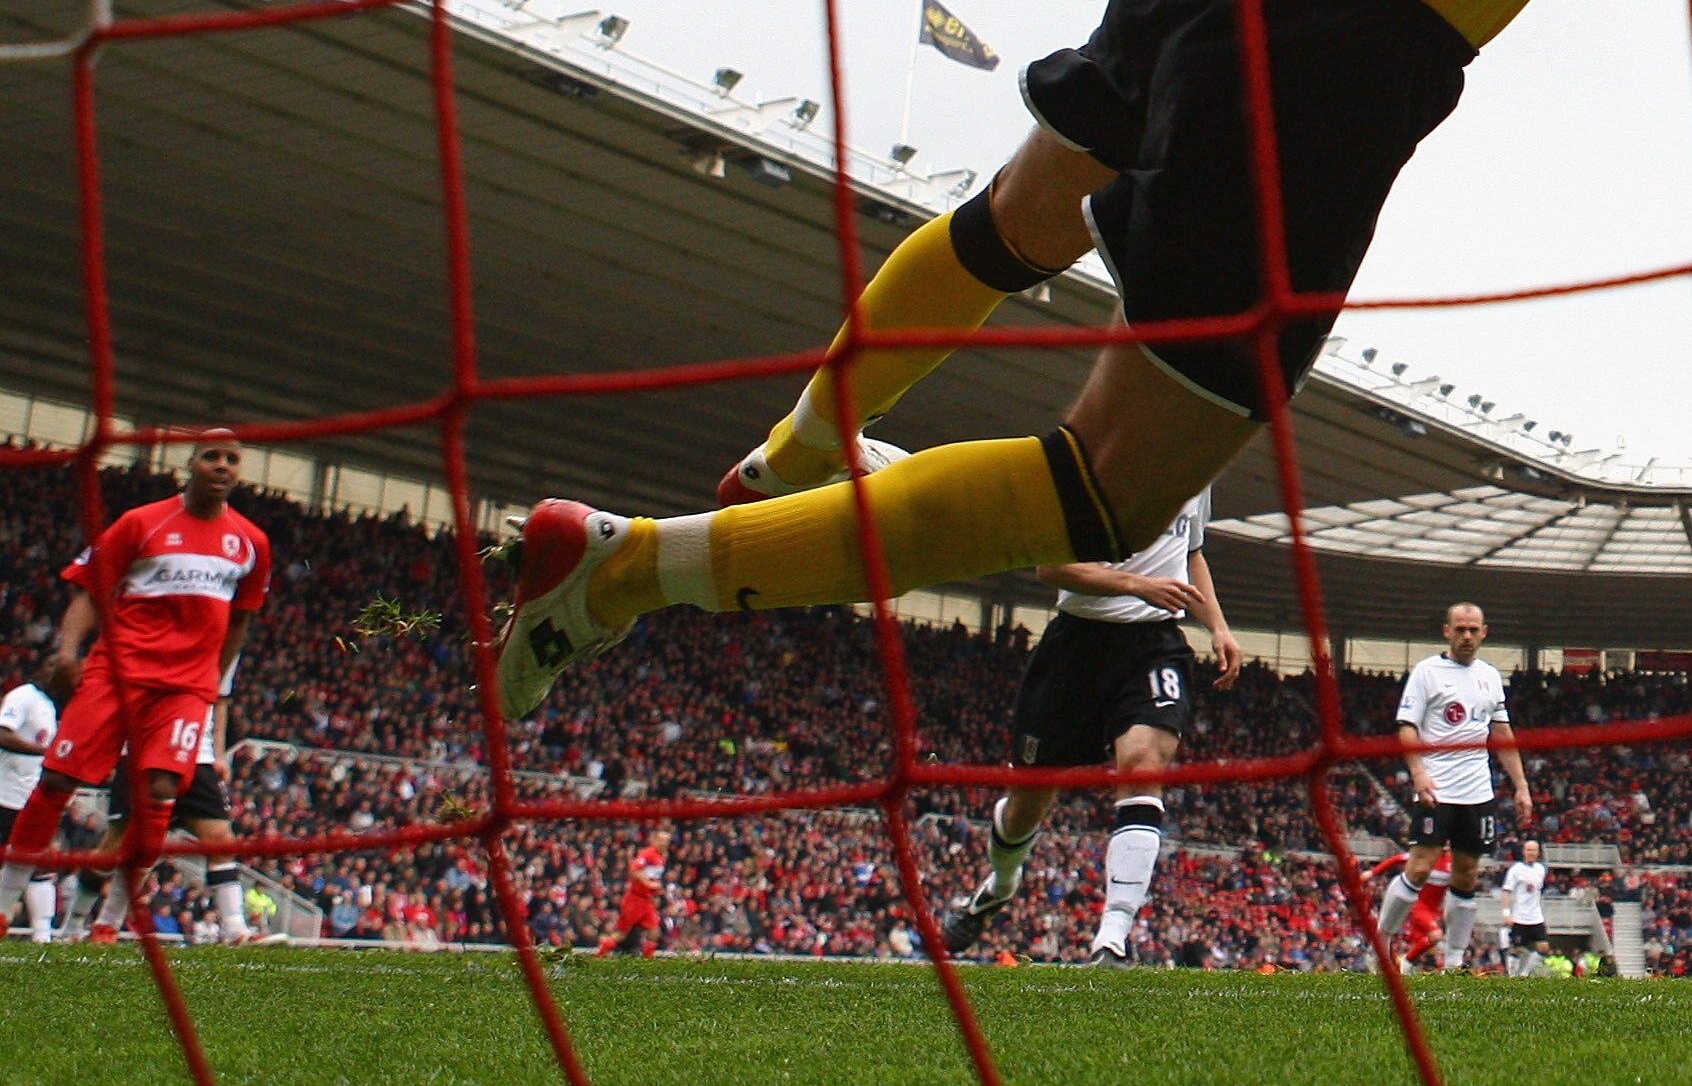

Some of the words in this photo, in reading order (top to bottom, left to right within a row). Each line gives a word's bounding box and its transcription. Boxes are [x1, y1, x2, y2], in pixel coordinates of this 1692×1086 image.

[1148, 667, 1181, 699] 18
[170, 718, 200, 751] 16
[1480, 816, 1495, 839] 13
